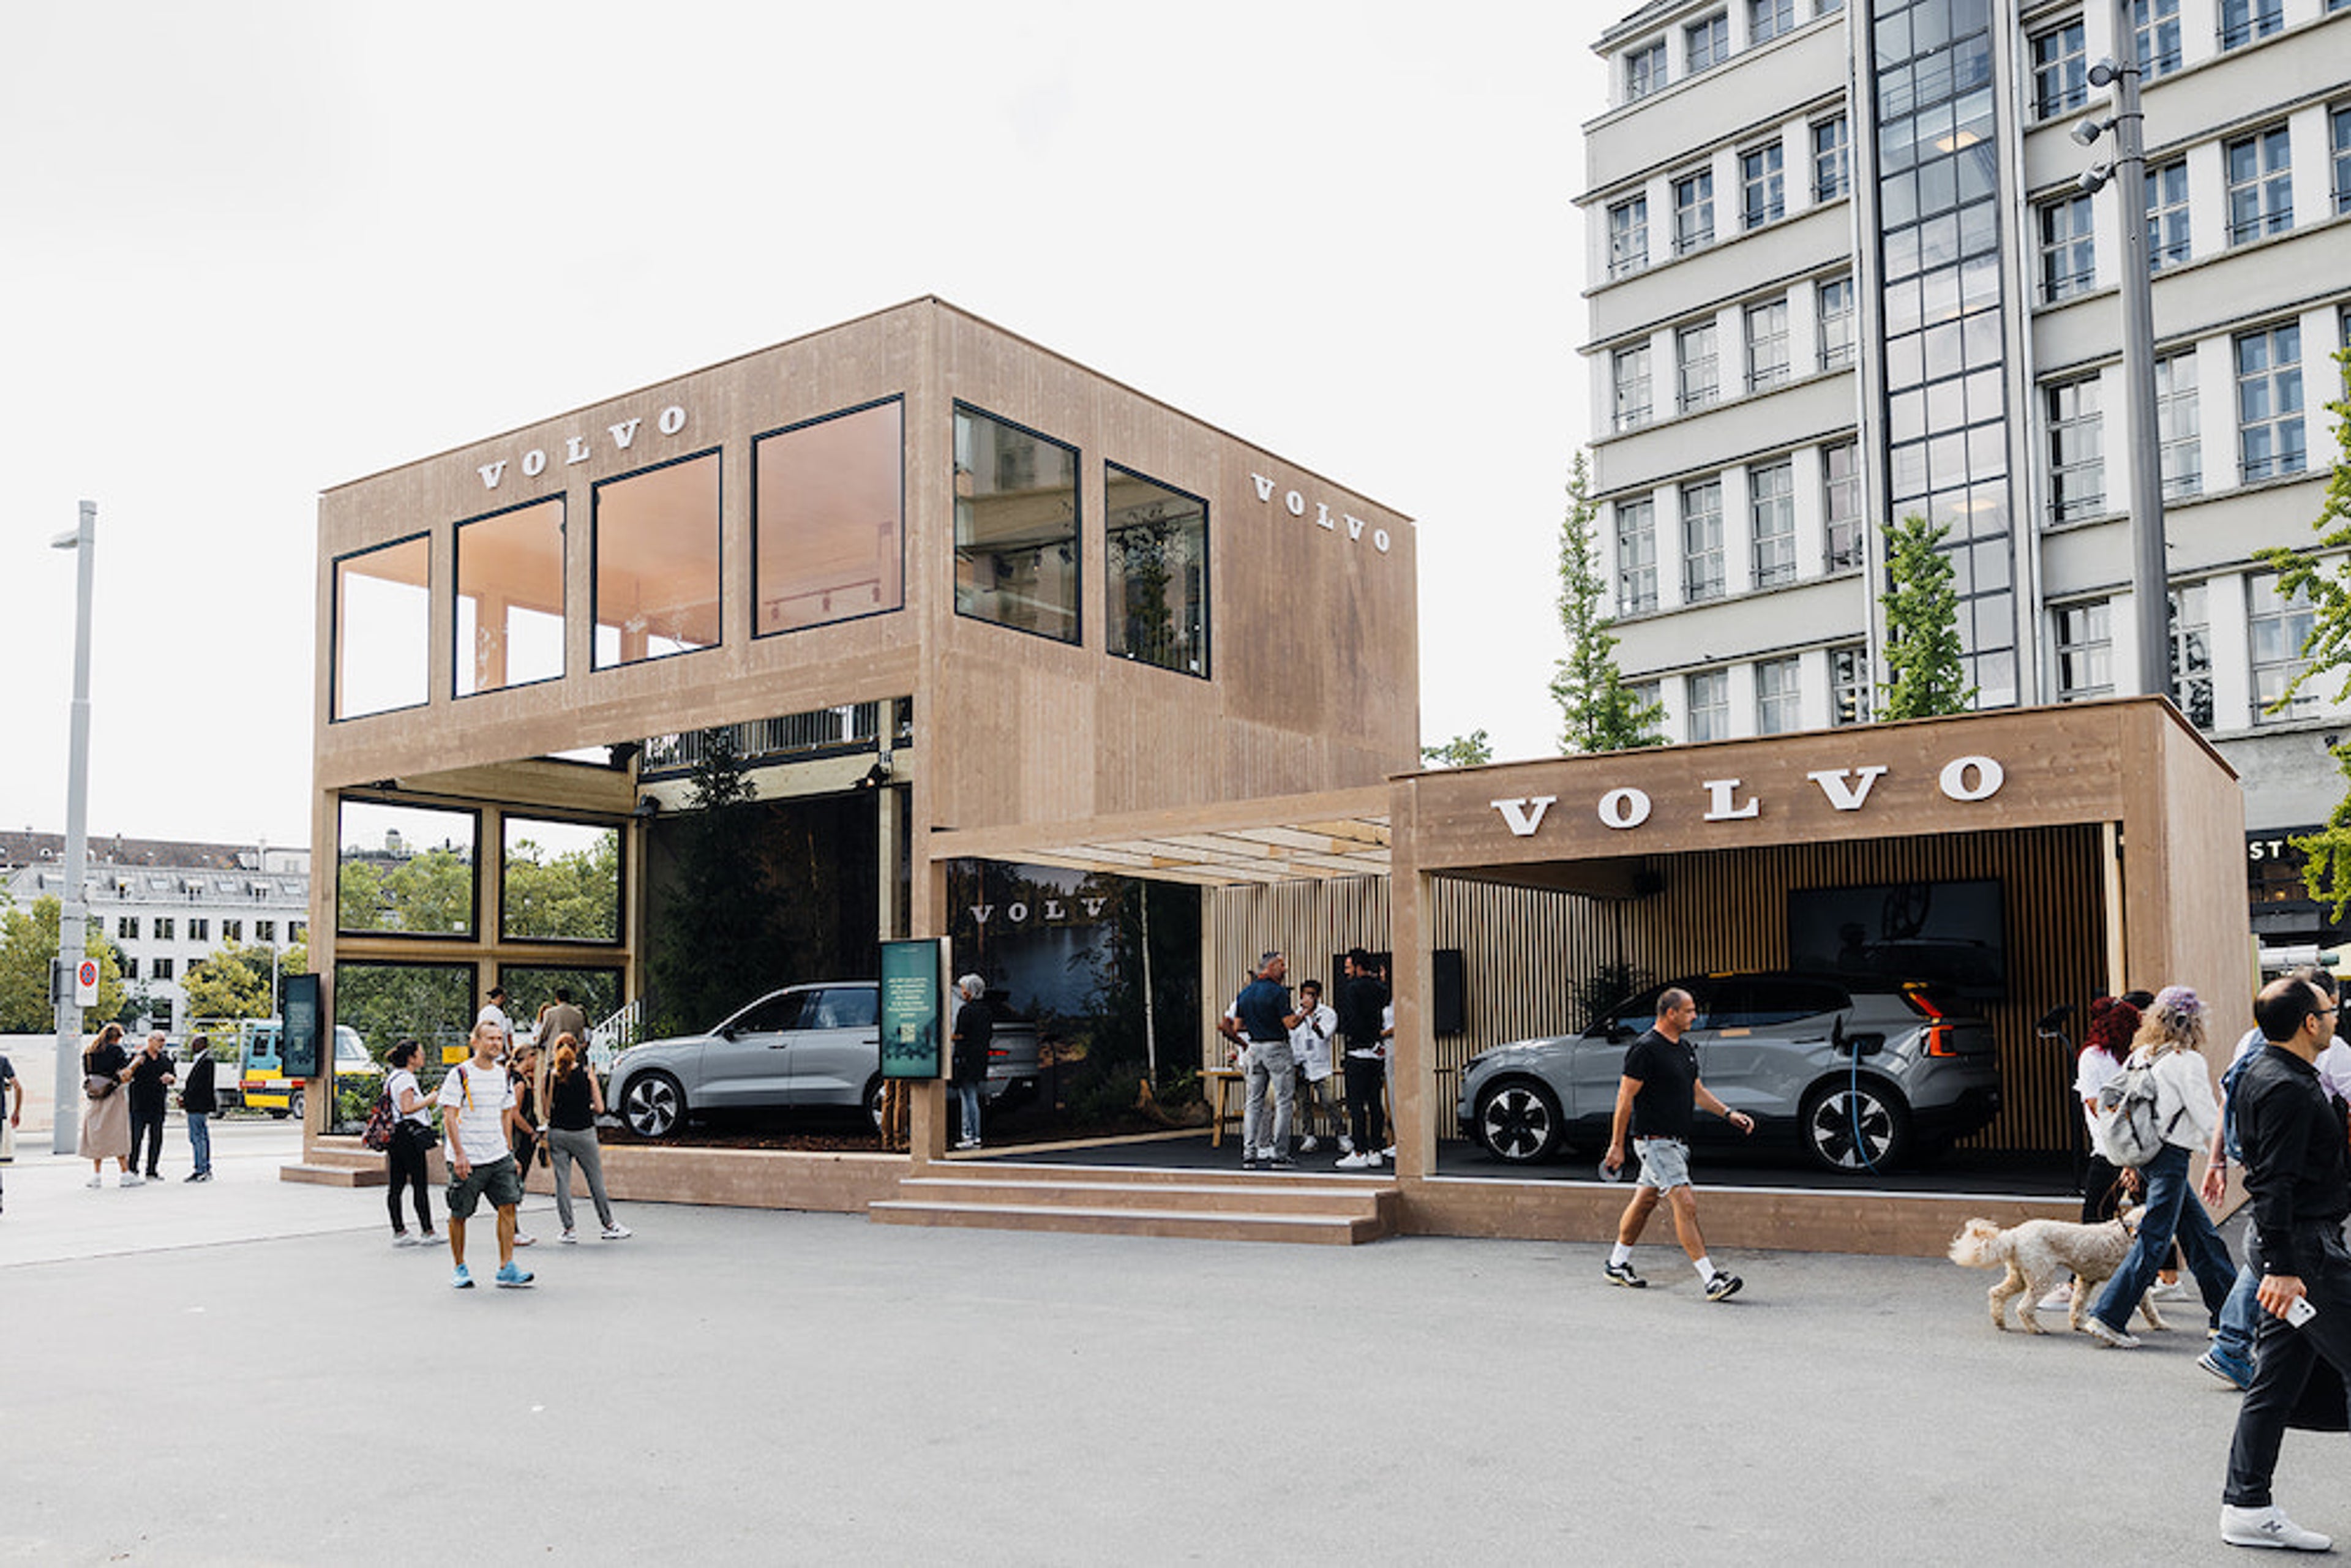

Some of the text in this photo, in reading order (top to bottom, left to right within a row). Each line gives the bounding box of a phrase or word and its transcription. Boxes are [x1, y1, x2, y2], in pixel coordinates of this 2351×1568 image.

[478, 407, 686, 489] VOLVO
[1251, 472, 1390, 552] VOLVO
[1490, 756, 2004, 836] VOLVO
[969, 898, 1130, 923] VOLV
